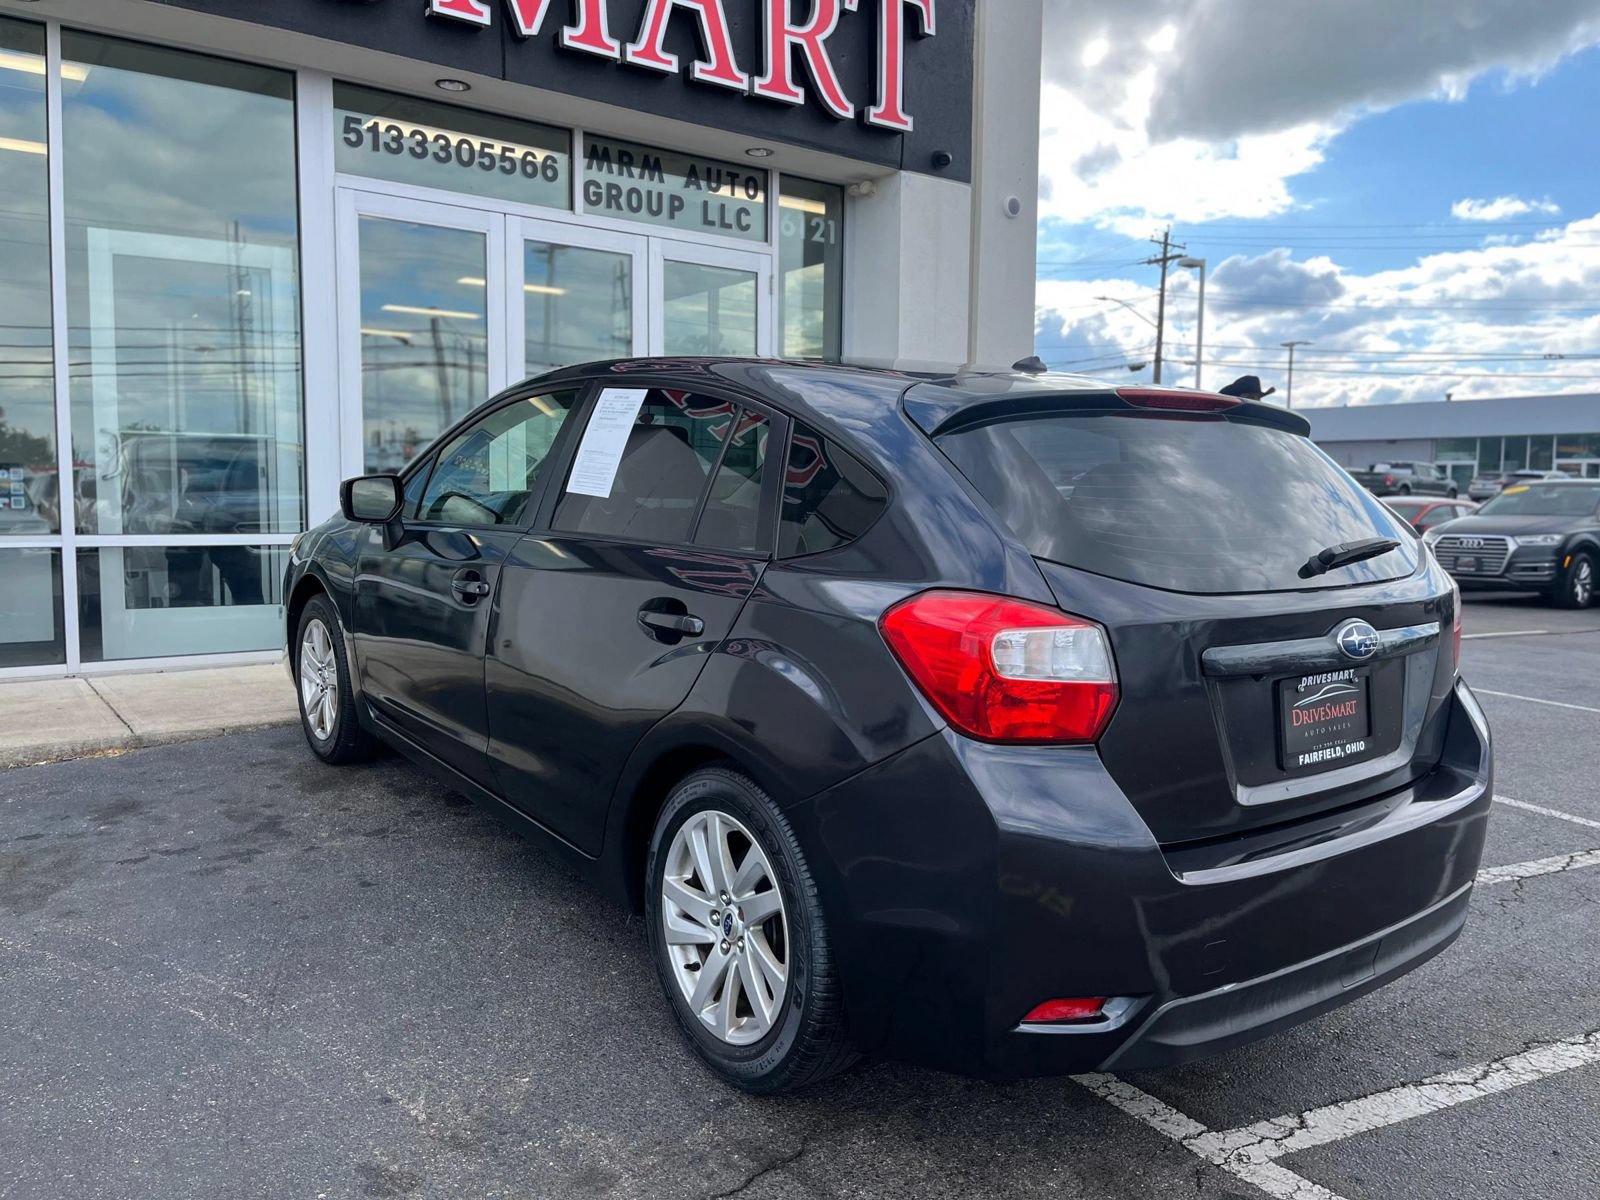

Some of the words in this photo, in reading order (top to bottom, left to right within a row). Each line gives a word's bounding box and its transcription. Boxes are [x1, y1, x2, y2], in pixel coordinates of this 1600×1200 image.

[425, 0, 936, 131] ART
[342, 115, 560, 183] 5133305566
[587, 143, 665, 185] MRM
[684, 163, 760, 201] AUTO
[583, 179, 686, 221] GROUP
[702, 205, 752, 233] LLC
[1301, 669, 1355, 687] DRIVESMART
[1298, 746, 1345, 766] FAIRFIELD,
[1345, 740, 1365, 754] OHIO
[1304, 727, 1326, 737] AUTO
[1328, 722, 1351, 733] SALES
